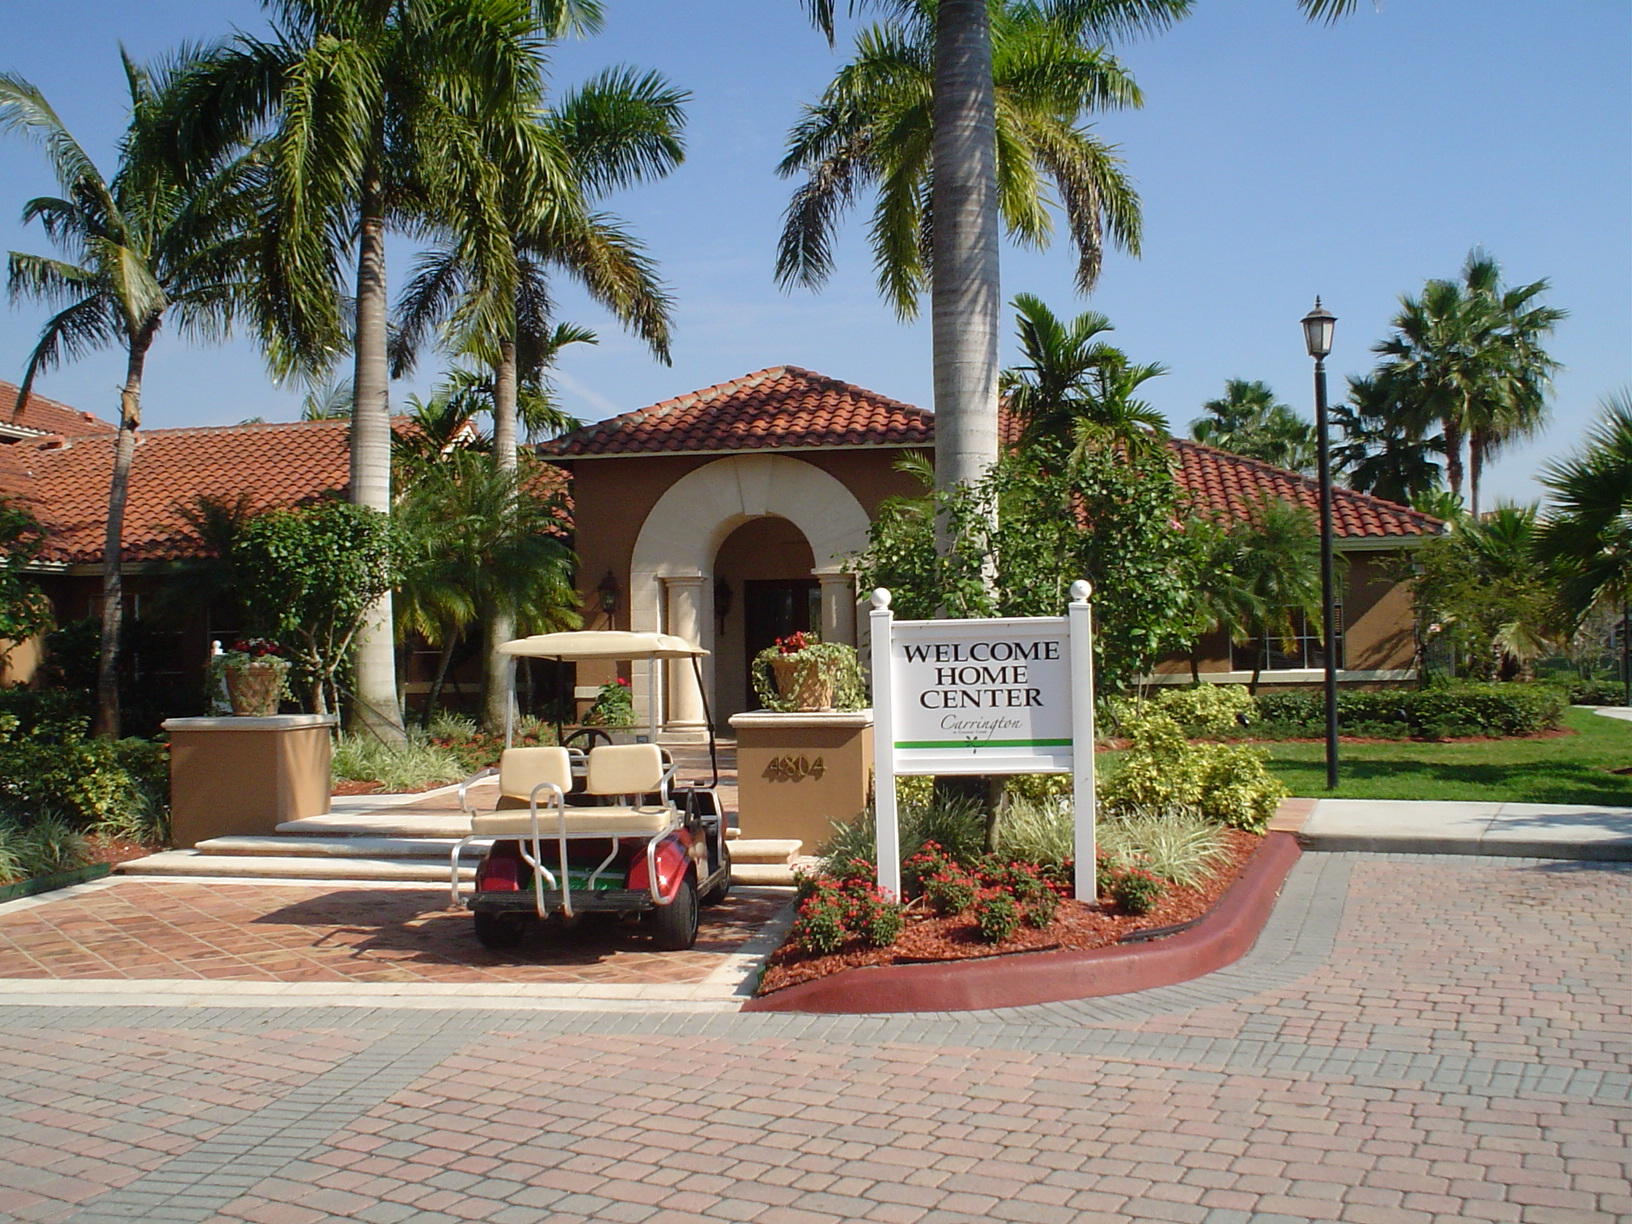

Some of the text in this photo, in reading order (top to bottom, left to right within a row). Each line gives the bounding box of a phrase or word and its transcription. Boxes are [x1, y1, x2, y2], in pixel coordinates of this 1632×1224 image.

[903, 641, 1060, 663] WELCOME
[935, 666, 1028, 685] HOME
[920, 688, 1044, 708] CENTER
[940, 714, 1023, 738] Carrington
[765, 754, 827, 781] 4804
